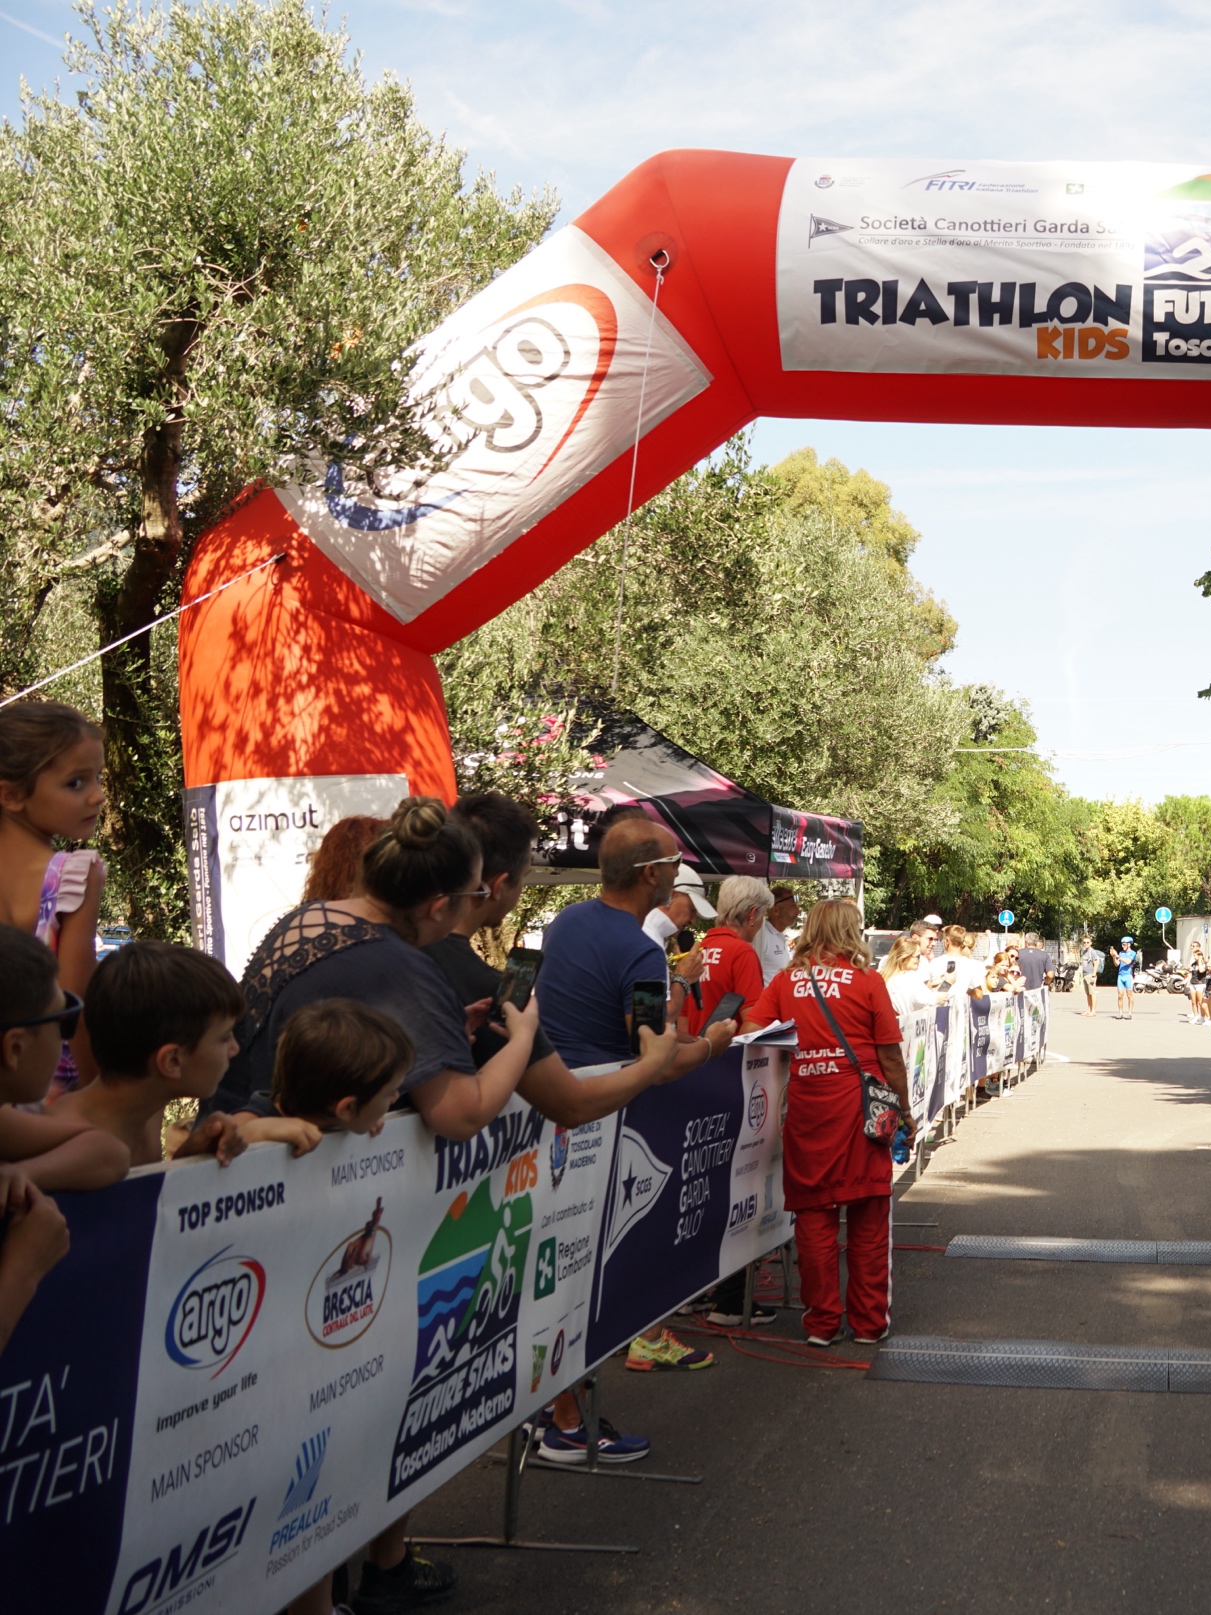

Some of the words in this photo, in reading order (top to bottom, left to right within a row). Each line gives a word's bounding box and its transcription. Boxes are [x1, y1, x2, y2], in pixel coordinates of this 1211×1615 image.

[925, 179, 976, 191] FITRI
[859, 237, 889, 245] Collare
[923, 238, 947, 246] Stella
[984, 239, 1014, 247] Merito
[1016, 240, 1052, 249] Sportivo
[1060, 241, 1096, 249] Fondata
[860, 216, 927, 230] Società
[934, 218, 1027, 233] Canottieri
[1033, 220, 1090, 234] Garda
[813, 277, 1133, 328] TRIATHLON
[1036, 324, 1131, 360] KIDS
[229, 803, 319, 832] azimut
[793, 981, 841, 999] GARA
[798, 1061, 840, 1077] GARA
[331, 1163, 357, 1188] MAIN
[359, 1149, 405, 1179] SPONSOR
[434, 1106, 546, 1195] TRIATHLON
[681, 1138, 735, 1181] CANOTTIERI
[503, 1148, 539, 1198] KIDS
[635, 1176, 652, 1197] SCGS
[679, 1175, 711, 1213] GARDA
[178, 1201, 211, 1233] TOP
[214, 1181, 285, 1223] SPONSOR
[729, 1192, 758, 1229] OMSI
[558, 1234, 590, 1260] Regione
[179, 1272, 252, 1355] argo
[323, 1276, 373, 1324] BRESCIA
[212, 1383, 238, 1410] your
[241, 1372, 258, 1392] life
[309, 1385, 337, 1413] MAIN
[338, 1354, 384, 1397] SPONSOR
[399, 1366, 468, 1444] FUTURE
[464, 1333, 515, 1399] STARS
[394, 1423, 457, 1487] Toscolano
[457, 1387, 513, 1439] Maderno
[151, 1459, 191, 1503] MAIN
[194, 1424, 259, 1479] SPONSOR
[266, 1544, 300, 1580] Passion
[302, 1534, 313, 1553] for
[314, 1514, 337, 1545] Road
[336, 1502, 361, 1528] Safety
[269, 1495, 332, 1556] PREALUX
[117, 1495, 258, 1615] OMSI
